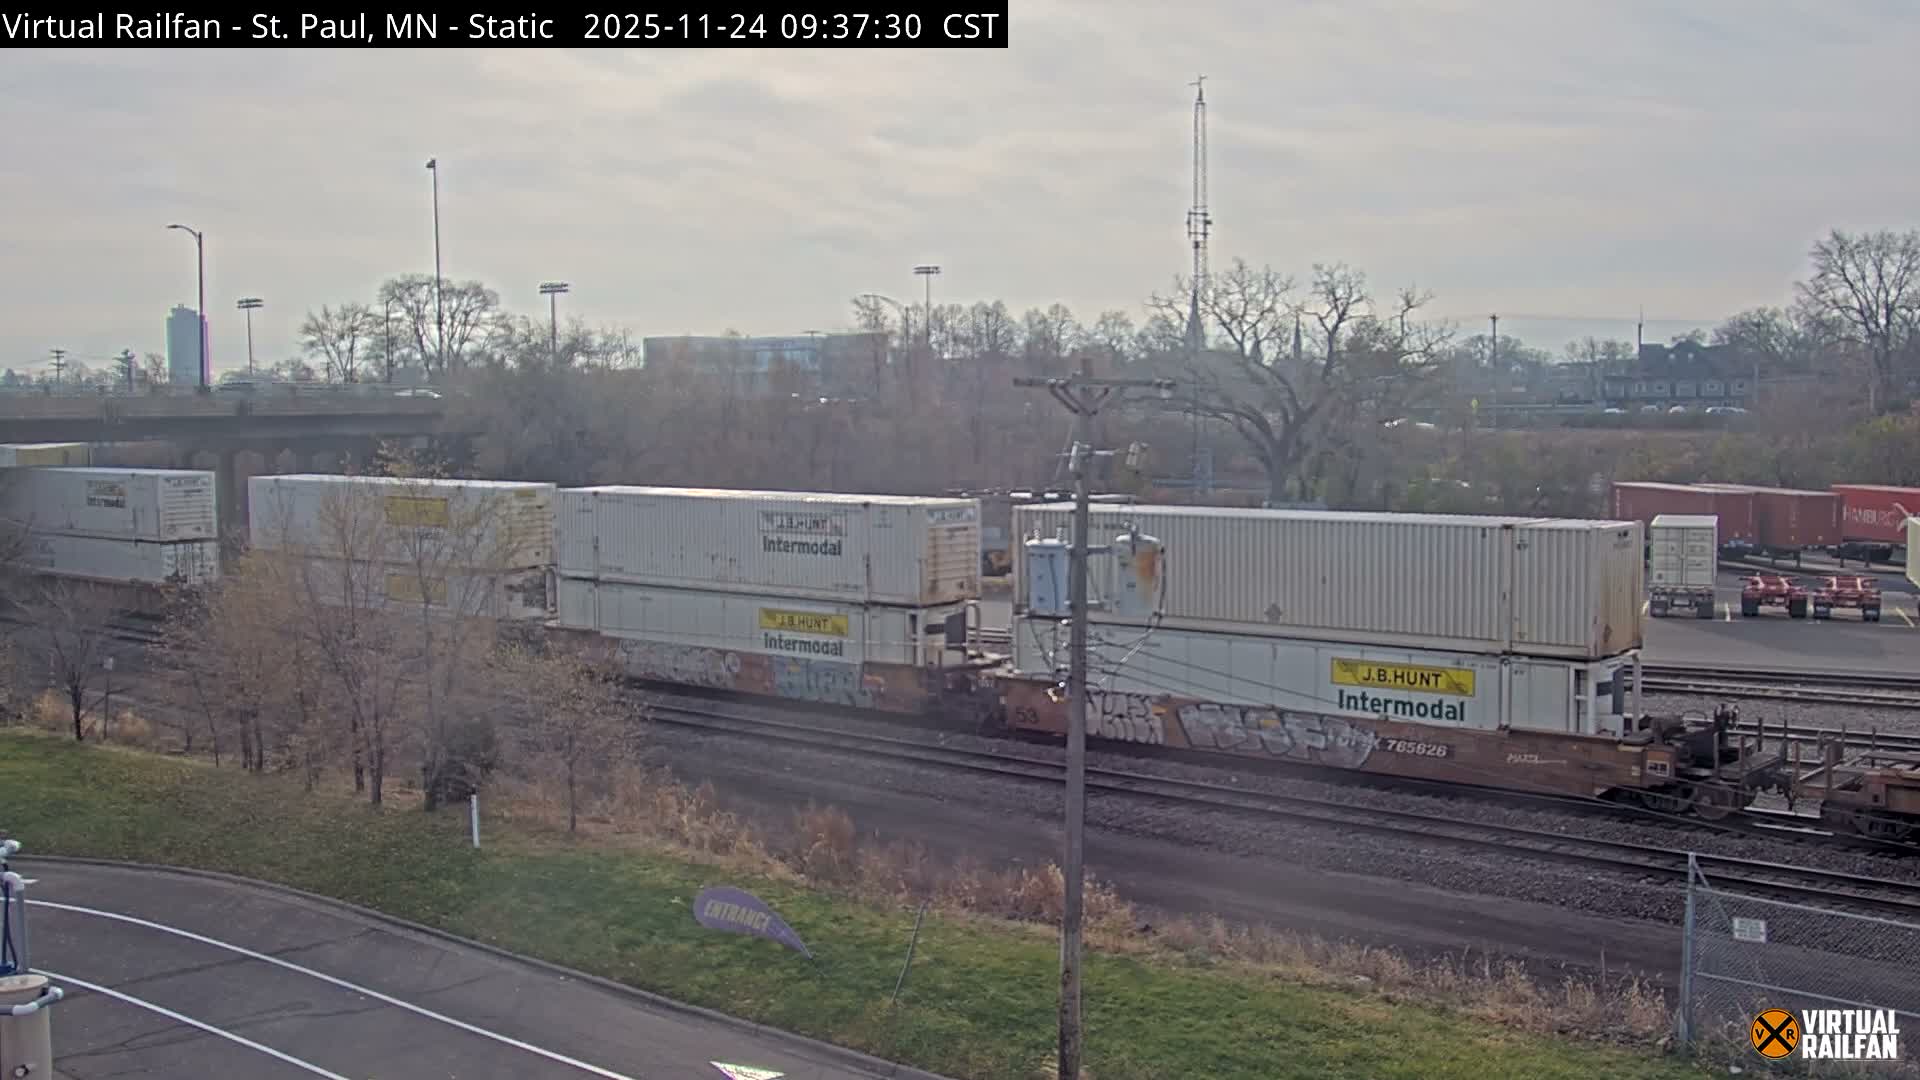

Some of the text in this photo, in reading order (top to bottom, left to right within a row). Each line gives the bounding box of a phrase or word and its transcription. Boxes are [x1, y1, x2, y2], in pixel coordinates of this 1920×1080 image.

[763, 535, 842, 556] Intermodal
[764, 632, 844, 656] Intermodal
[1362, 667, 1442, 688] J.B.HUNT
[1338, 688, 1465, 721] Intermodal
